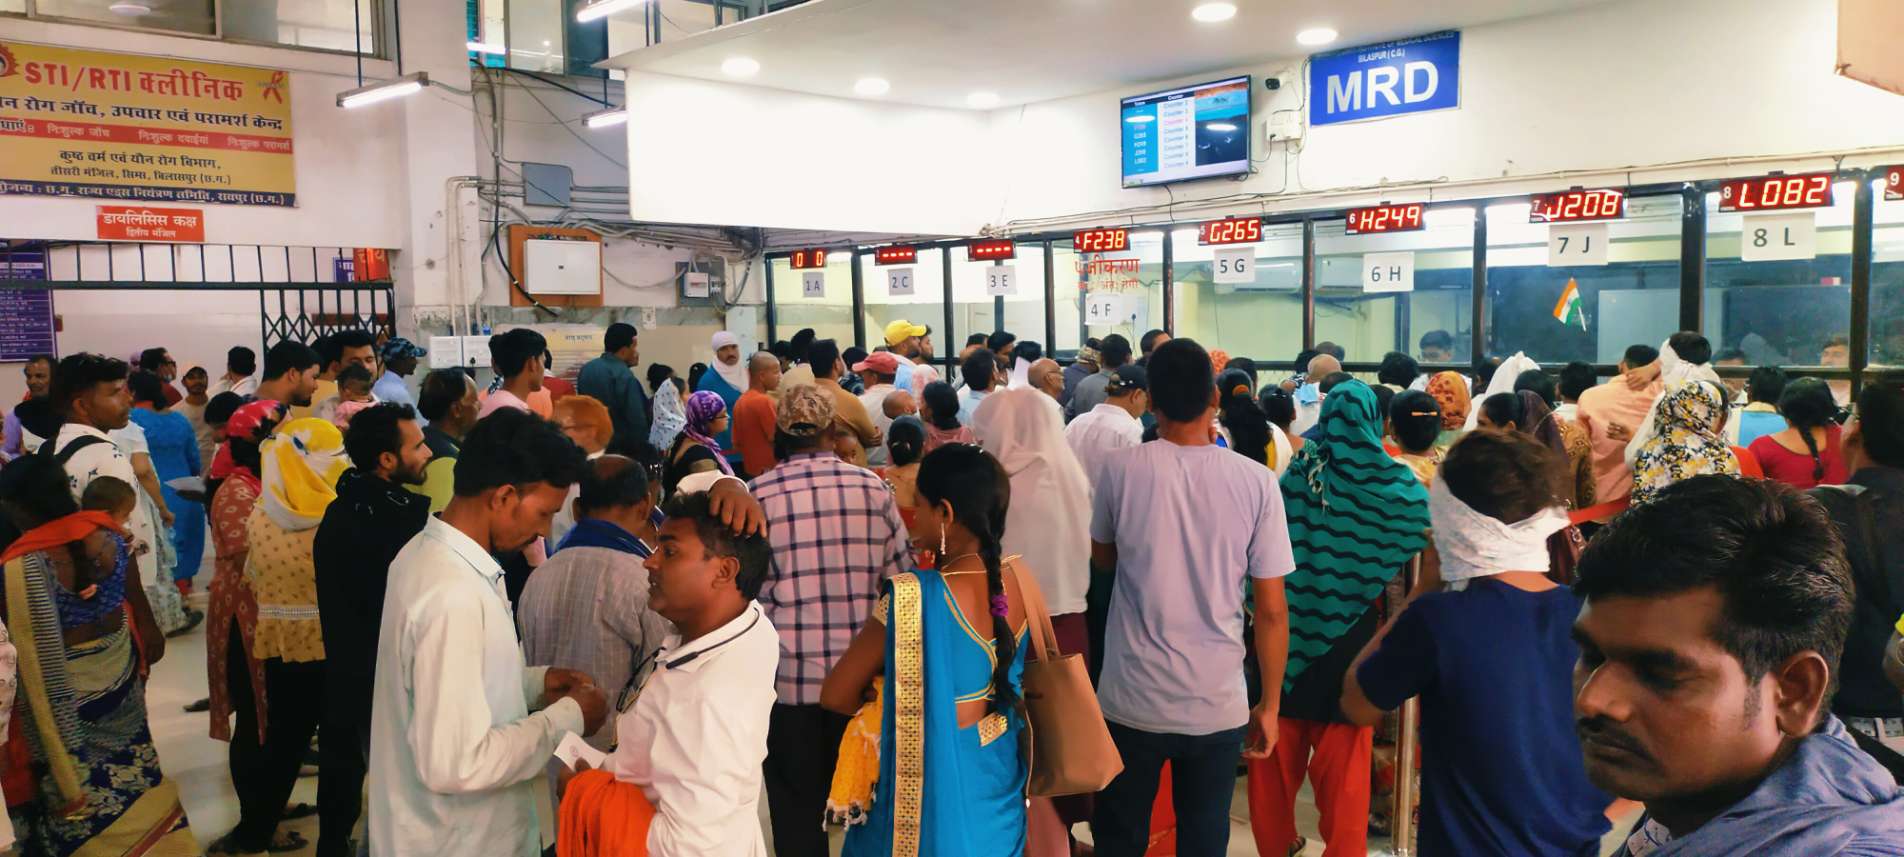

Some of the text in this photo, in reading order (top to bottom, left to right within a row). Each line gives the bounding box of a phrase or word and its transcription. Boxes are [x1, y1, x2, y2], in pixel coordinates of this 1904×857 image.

[25, 62, 244, 101] STI/RTI क्लीनिक
[1326, 60, 1439, 115] MRD
[24, 96, 56, 112] रोग
[111, 104, 162, 121] उपचार
[166, 108, 189, 123] एवं
[194, 111, 249, 127] परामर्श
[251, 114, 283, 130] केन्द्र
[157, 154, 177, 166] रोग
[1890, 172, 1900, 187] 9
[1723, 176, 1828, 208] 8 L082
[1546, 192, 1619, 219] J208
[103, 209, 198, 228] डायलिसिस कक्ष
[1349, 206, 1420, 231] 6 H249
[1083, 230, 1125, 250] F238
[1209, 219, 1259, 243] G265
[1753, 227, 1796, 247] 8 L
[1557, 235, 1590, 254] 7 J
[1219, 258, 1245, 274] 5 G
[1371, 266, 1401, 282] 6 H
[805, 280, 821, 292] 1 A
[892, 276, 909, 289] 2 C
[990, 274, 1008, 288] 3 E
[1091, 303, 1111, 316] 4 F
